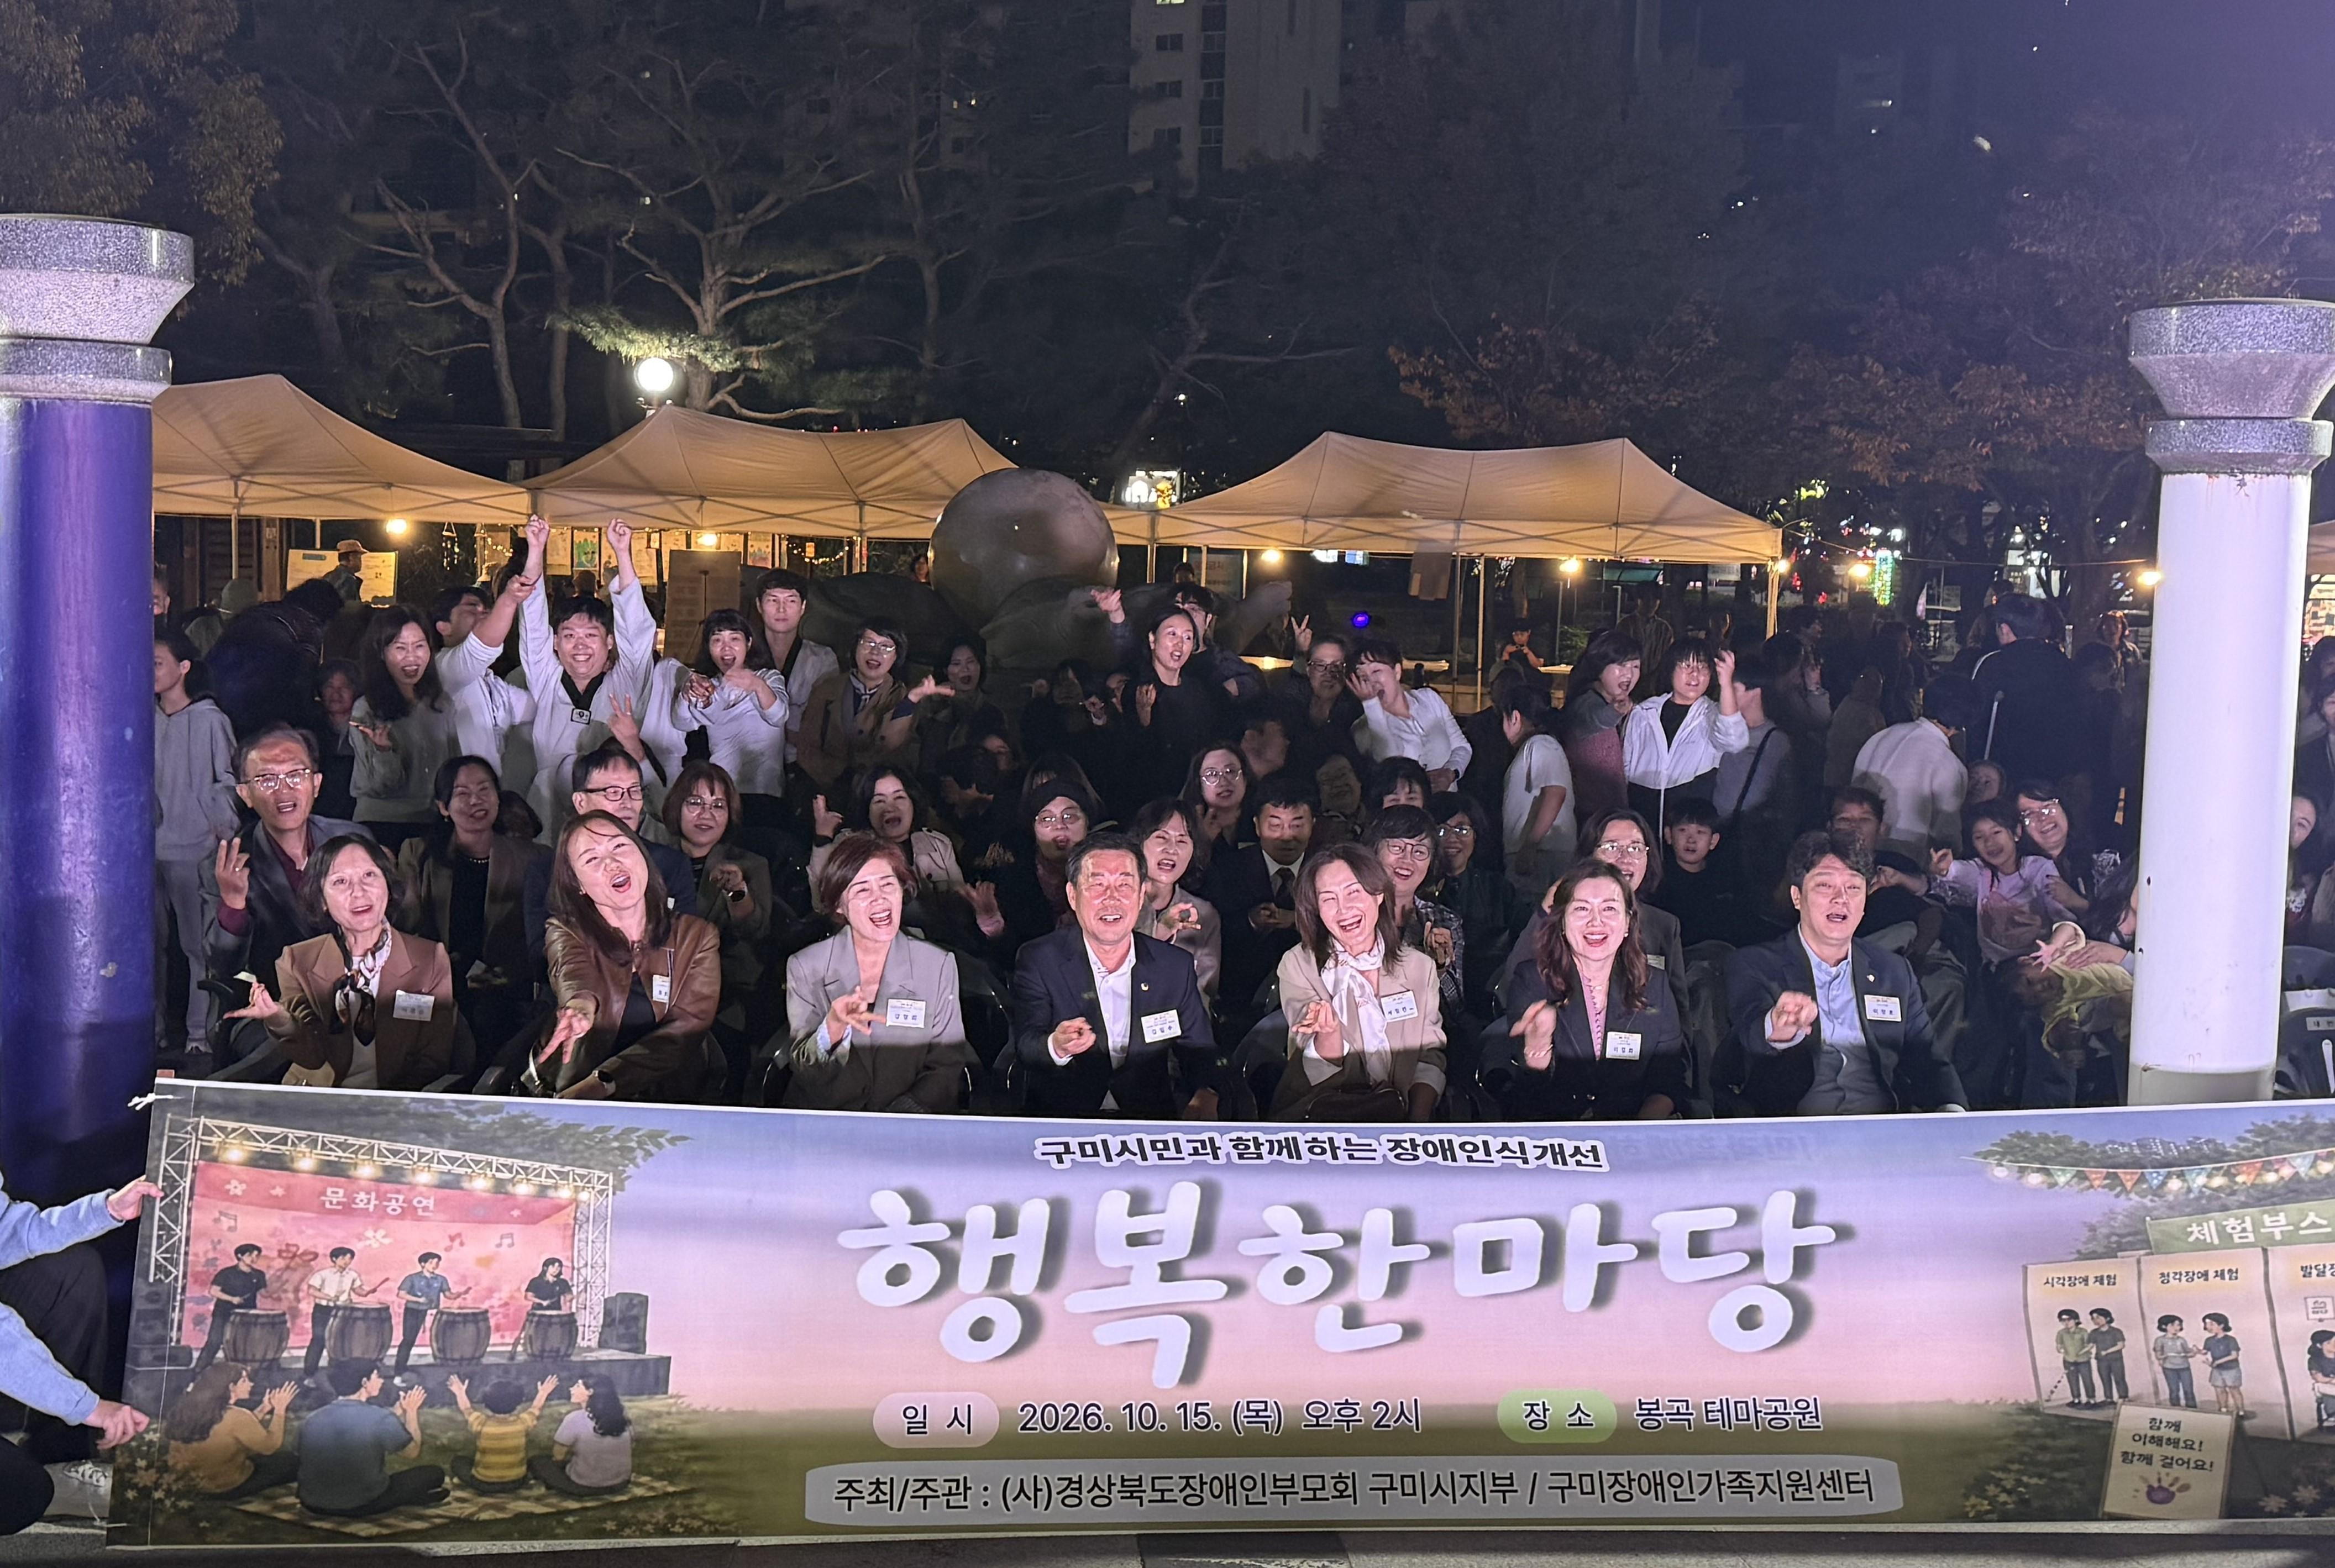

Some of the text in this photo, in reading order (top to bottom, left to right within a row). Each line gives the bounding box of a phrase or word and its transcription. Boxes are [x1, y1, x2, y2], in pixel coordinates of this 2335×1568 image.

[1041, 1137, 1220, 1164] 구미시민과
[1230, 1136, 1376, 1162] 함께하는
[1388, 1137, 1602, 1169] 장애인식개선
[321, 1186, 435, 1215] 문화공연
[2187, 1213, 2333, 1244] 체험부스
[837, 1181, 1837, 1389] 행복한마당
[1018, 1402, 1111, 1432] 2026.
[1121, 1402, 1166, 1432] 10.
[1176, 1402, 1221, 1432] 15.
[1232, 1398, 1283, 1436] (목)
[1302, 1397, 1365, 1433] 오후
[1372, 1398, 1421, 1433] 2시
[1634, 1397, 1696, 1431] 봉곡
[1704, 1397, 1823, 1431] 테마공원
[835, 1476, 972, 1513] 주최/주관
[1001, 1472, 1358, 1512] (사)경상북도장애인부모회
[1368, 1470, 1519, 1505] 구미시지부
[1548, 1469, 1874, 1504] 구미장애인가족지원센터
